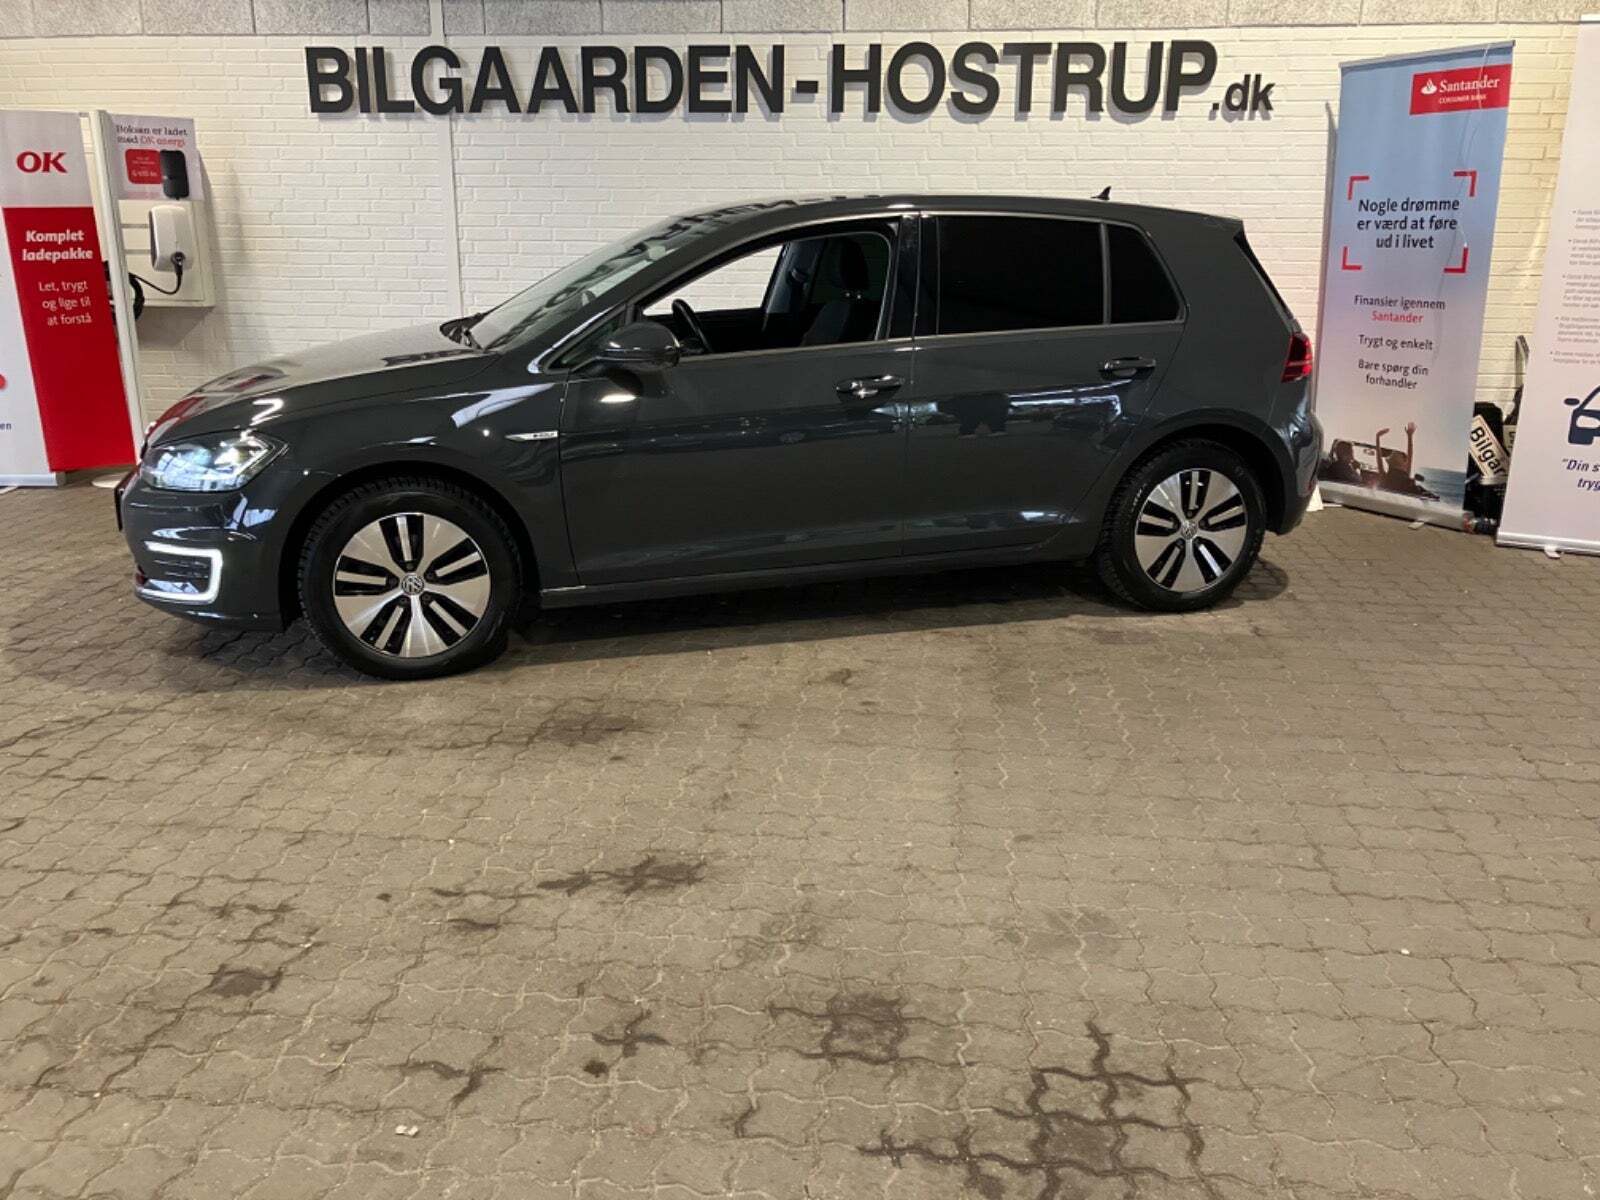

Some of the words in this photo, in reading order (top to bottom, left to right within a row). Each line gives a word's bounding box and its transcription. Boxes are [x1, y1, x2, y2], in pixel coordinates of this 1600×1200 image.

[1439, 75, 1500, 92] Santander
[16, 151, 68, 173] OK
[1358, 198, 1398, 216] Nogle
[1401, 197, 1460, 212] drømme
[1357, 220, 1373, 230] er
[1375, 216, 1407, 230] værd
[1410, 216, 1425, 230] at
[1429, 215, 1458, 231] føre
[26, 229, 85, 245] Komplet
[1376, 234, 1393, 248] ud
[1395, 234, 1401, 248] i
[1402, 234, 1435, 248] livet
[22, 247, 93, 264] ladepakke
[38, 282, 59, 291] Let,
[61, 280, 88, 293] trygt
[42, 300, 57, 311] og
[1354, 294, 1398, 307] Finansier
[1400, 296, 1446, 310] igennem
[47, 316, 58, 326] at
[60, 313, 92, 324] forstå
[1372, 310, 1424, 323] Santander
[1359, 334, 1384, 348] Trygt
[1385, 339, 1398, 350] og
[1400, 338, 1433, 350] enkelt
[1358, 359, 1380, 370] Bare
[1382, 362, 1410, 376] spørg
[1412, 365, 1429, 376] din
[1366, 373, 1418, 389] forhandler
